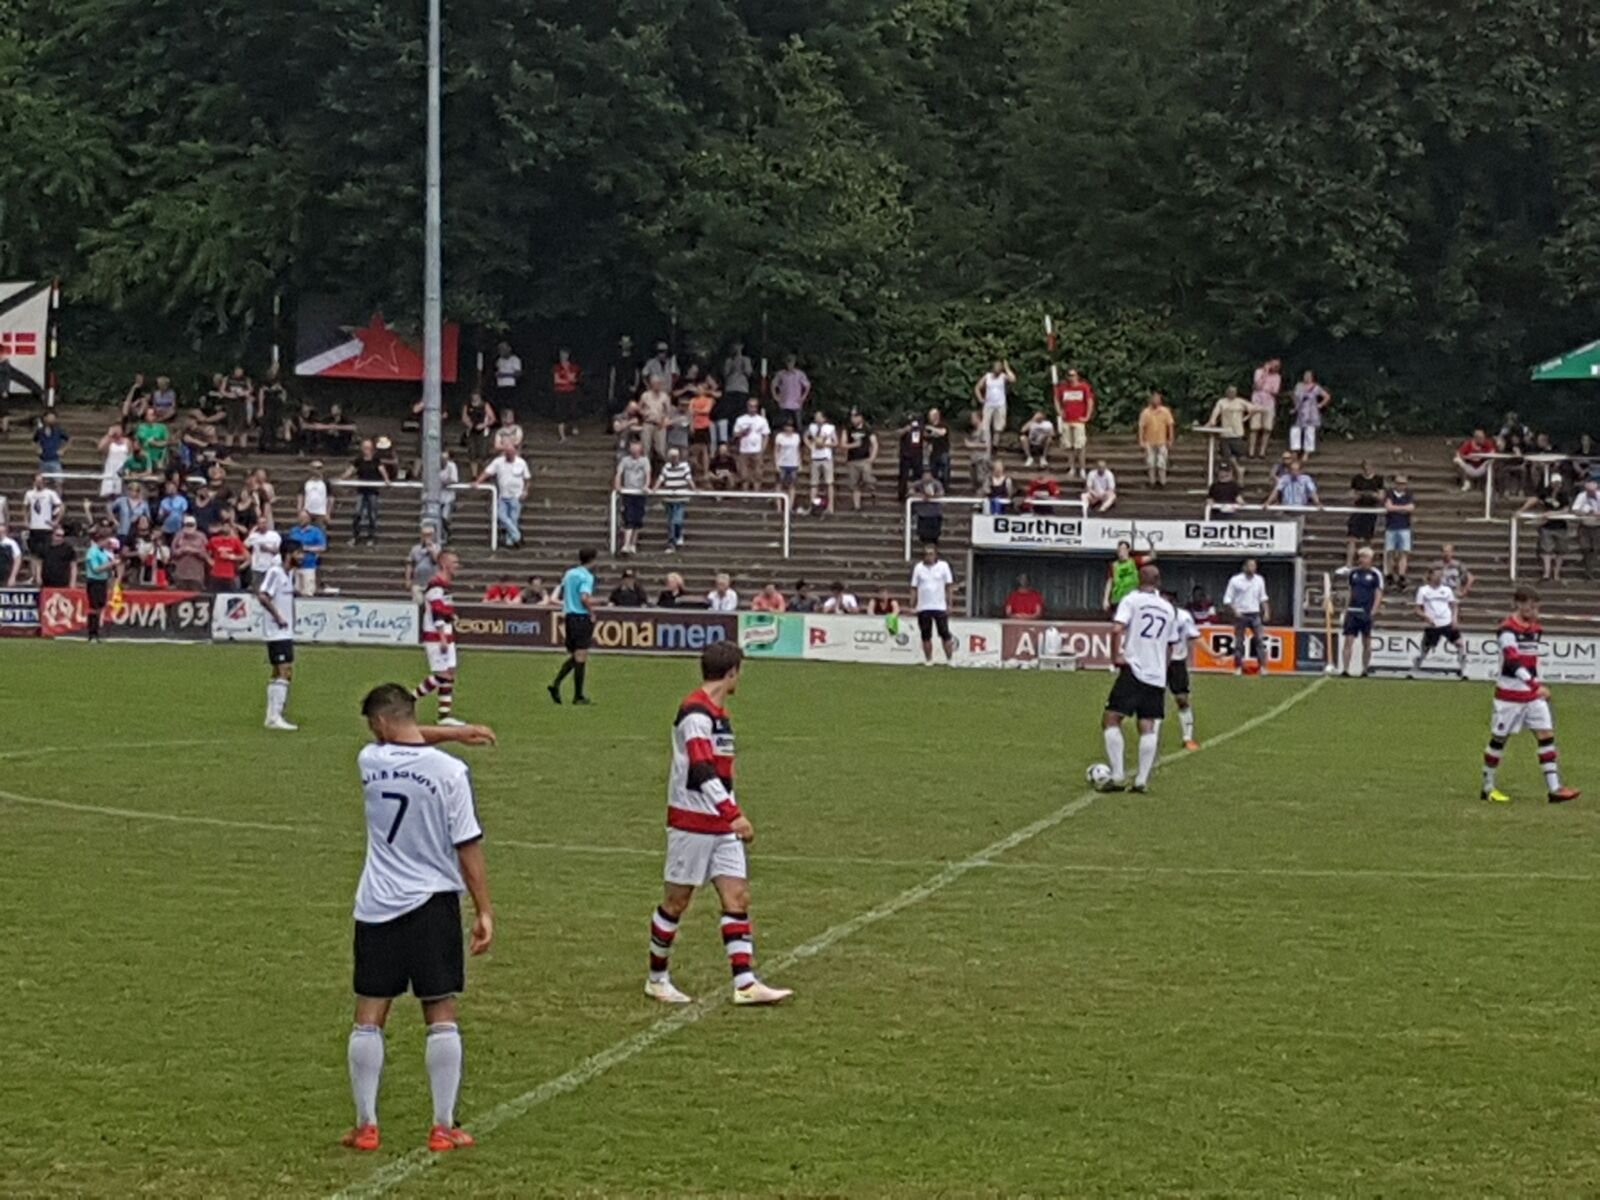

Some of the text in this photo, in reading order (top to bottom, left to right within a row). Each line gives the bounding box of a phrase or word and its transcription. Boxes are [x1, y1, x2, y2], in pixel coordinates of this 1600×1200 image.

[994, 517, 1082, 536] Barthel
[1185, 523, 1275, 540] Barthel
[178, 601, 210, 628] 93
[1140, 612, 1167, 639] 27
[551, 611, 654, 647] Rxona
[381, 790, 410, 844] 7
